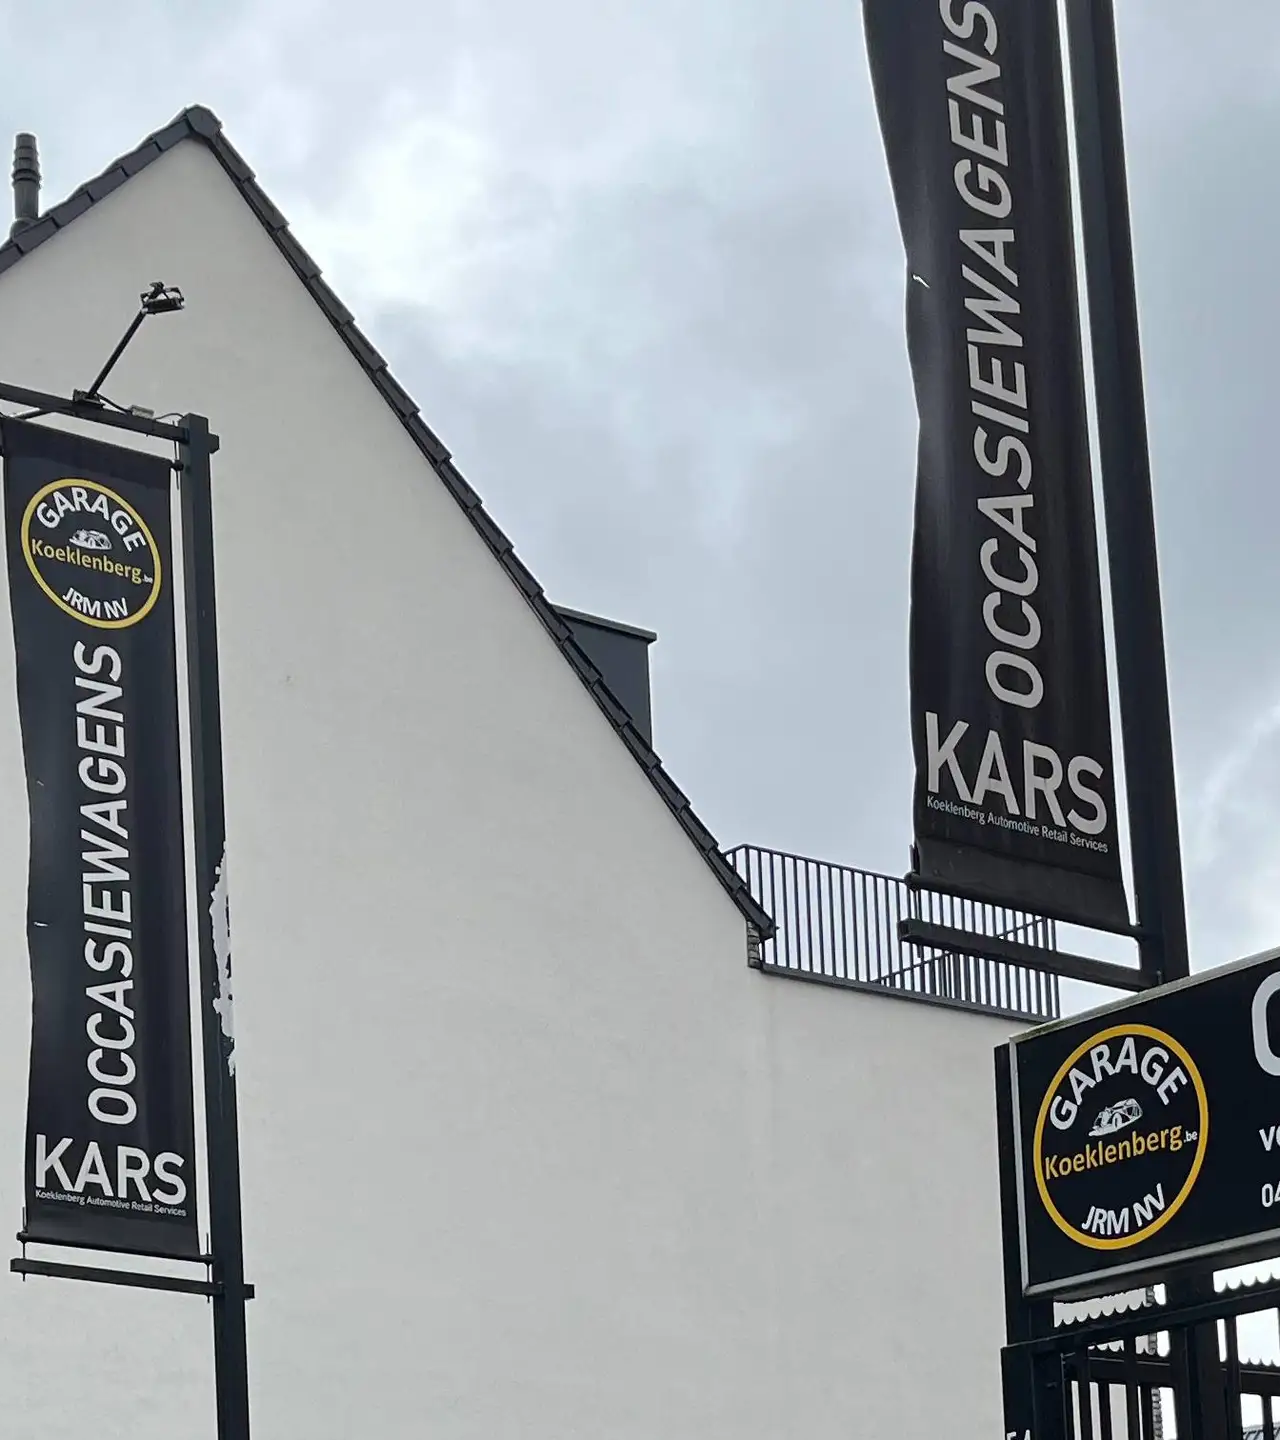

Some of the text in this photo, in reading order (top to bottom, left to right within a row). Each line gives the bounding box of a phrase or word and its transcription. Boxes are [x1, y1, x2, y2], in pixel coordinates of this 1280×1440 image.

[939, 0, 1044, 709] OCCASIEWAGENS
[36, 486, 147, 552] GARAGE
[62, 587, 129, 619] JRM NV
[925, 711, 1109, 835] KARS
[927, 795, 1108, 853] Koeklenberg Automotive Retail Services
[73, 640, 137, 1125] OCCASIEWAGENS
[1049, 1036, 1189, 1130] GARAGE
[35, 1133, 187, 1205] KARS
[1044, 1125, 1198, 1180] Koeklenberg.be
[35, 1189, 187, 1217] Koeklenberg Automotive Retail Services
[1081, 1182, 1166, 1235] JRM NV
